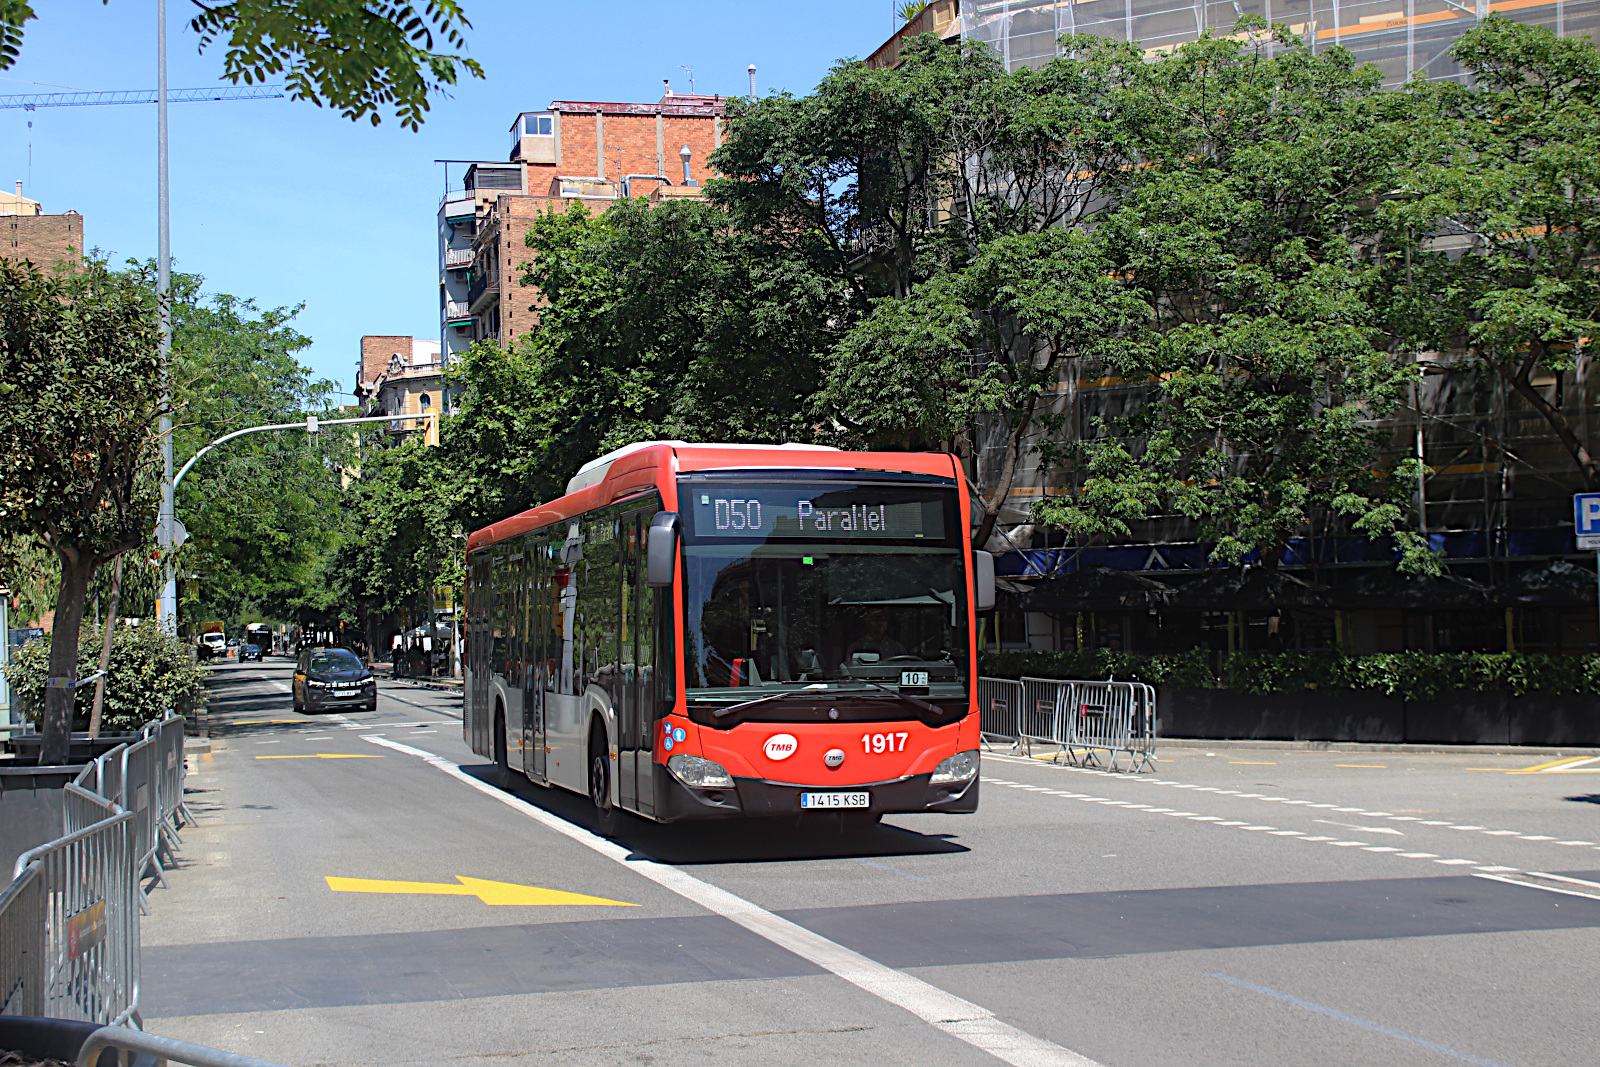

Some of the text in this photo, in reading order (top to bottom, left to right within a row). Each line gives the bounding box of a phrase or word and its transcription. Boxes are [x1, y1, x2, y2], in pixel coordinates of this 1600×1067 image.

[714, 499, 762, 530] D50
[1581, 497, 1600, 531] P
[905, 672, 919, 685] 10
[770, 743, 793, 752] TMB
[861, 732, 909, 754] 1917
[811, 794, 866, 806] 1415 KSB
